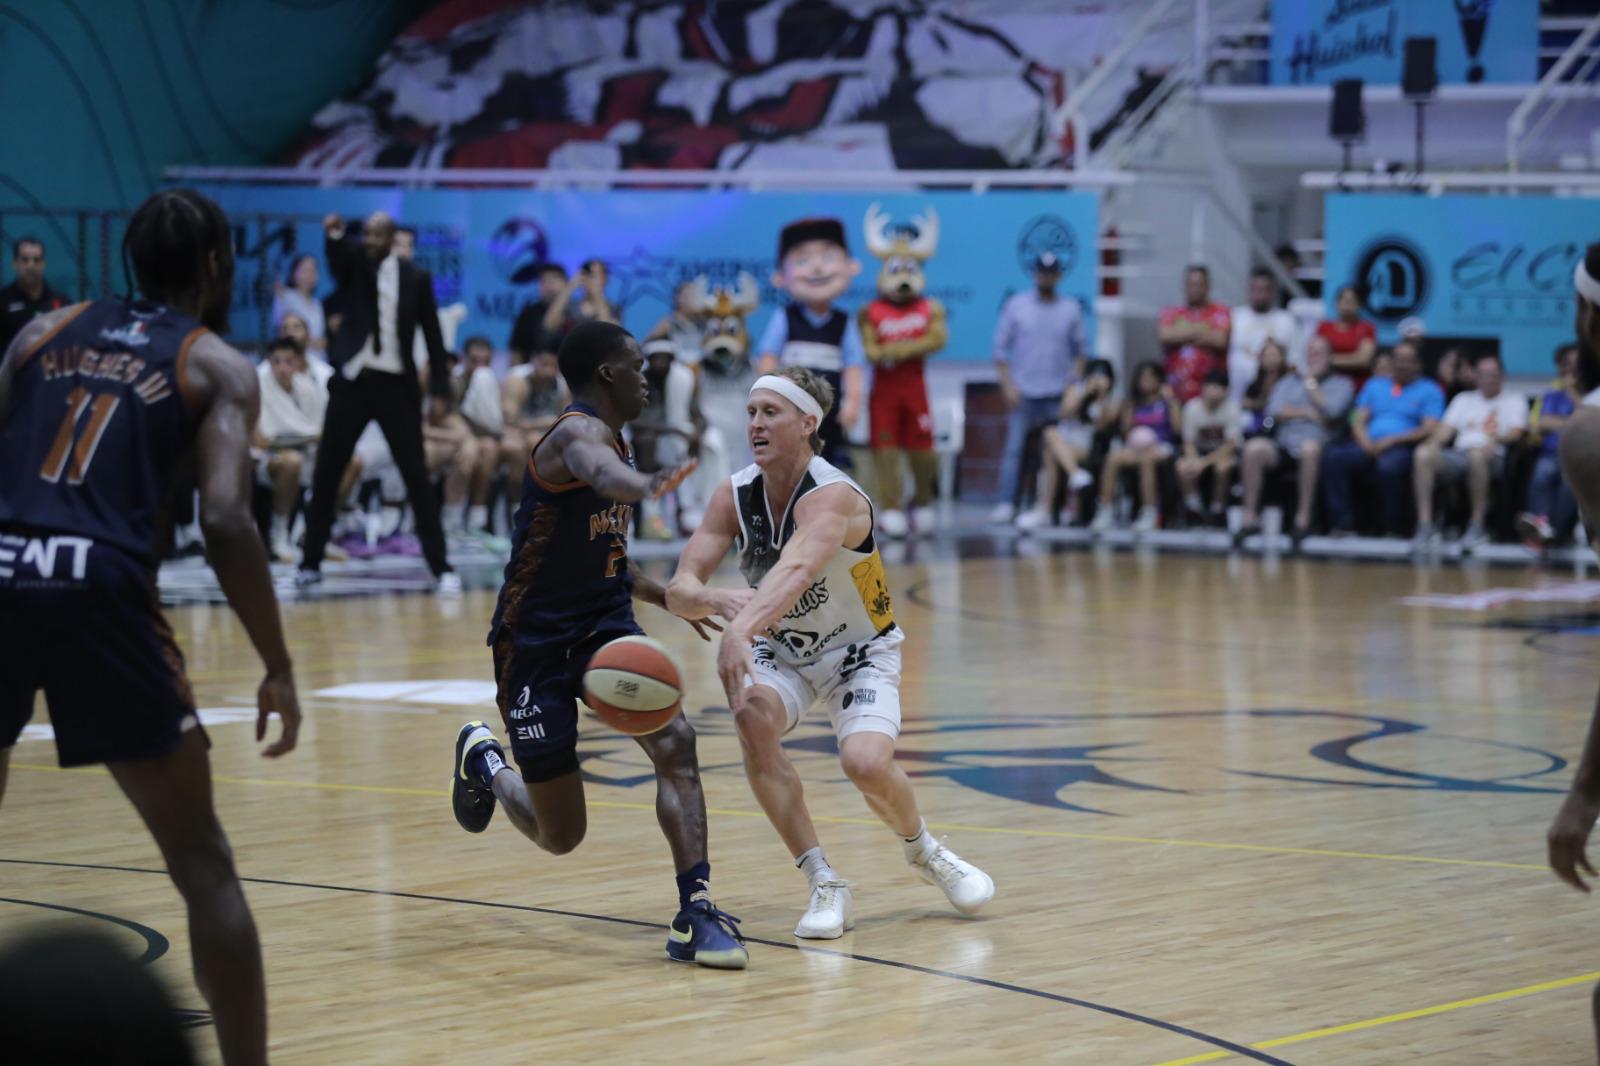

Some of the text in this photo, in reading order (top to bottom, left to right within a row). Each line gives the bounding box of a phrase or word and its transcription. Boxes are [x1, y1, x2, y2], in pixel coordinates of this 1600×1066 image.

[41, 349, 146, 384] HUGHES
[40, 387, 120, 485] 11
[510, 704, 542, 720] MEGA
